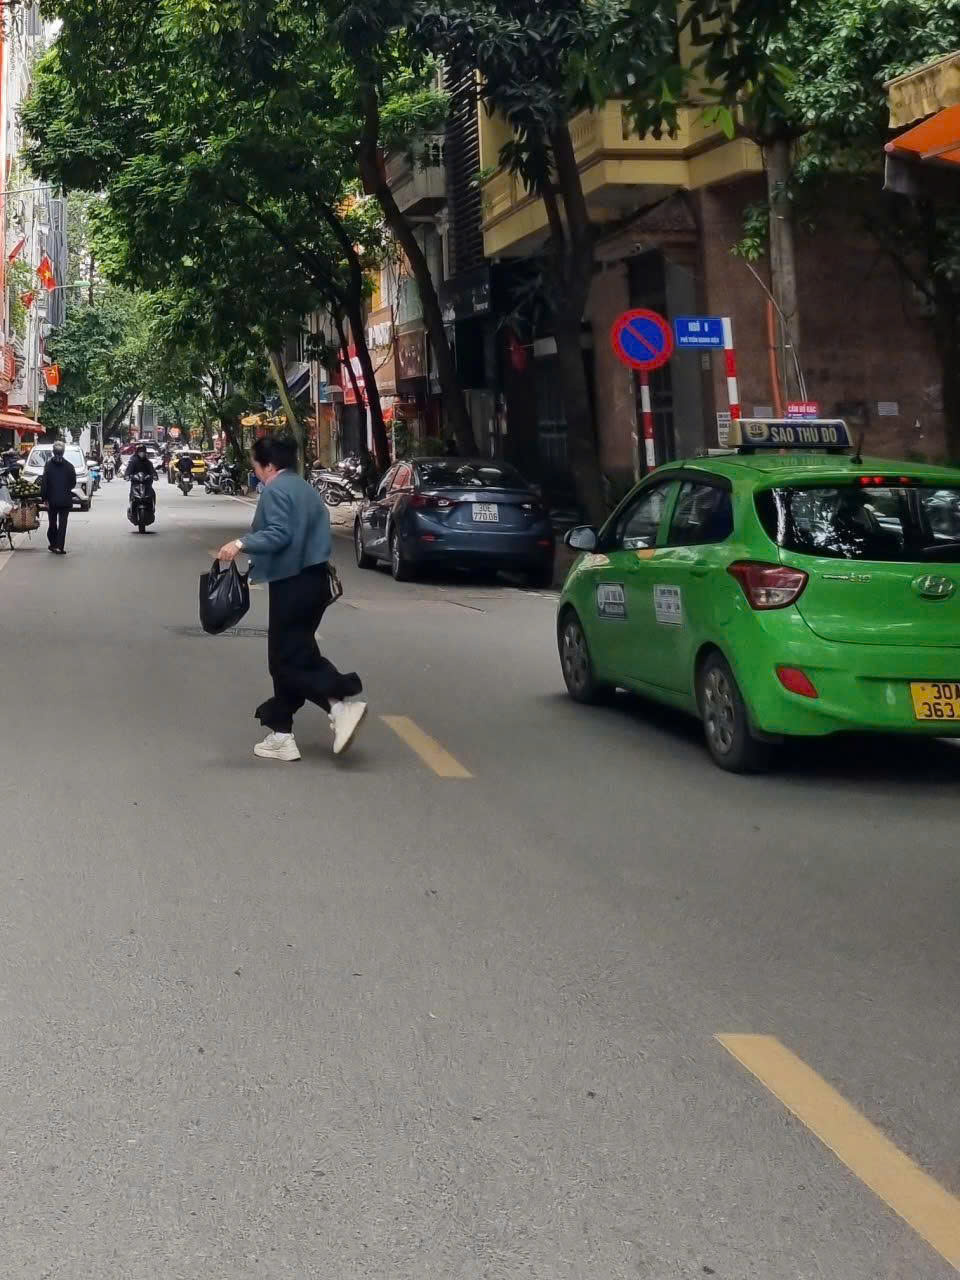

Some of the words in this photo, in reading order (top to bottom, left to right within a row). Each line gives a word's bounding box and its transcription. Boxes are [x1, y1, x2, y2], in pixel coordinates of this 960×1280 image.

[770, 427, 794, 442] SAO
[797, 424, 819, 442] THỦ
[821, 425, 837, 442] ĐÔ
